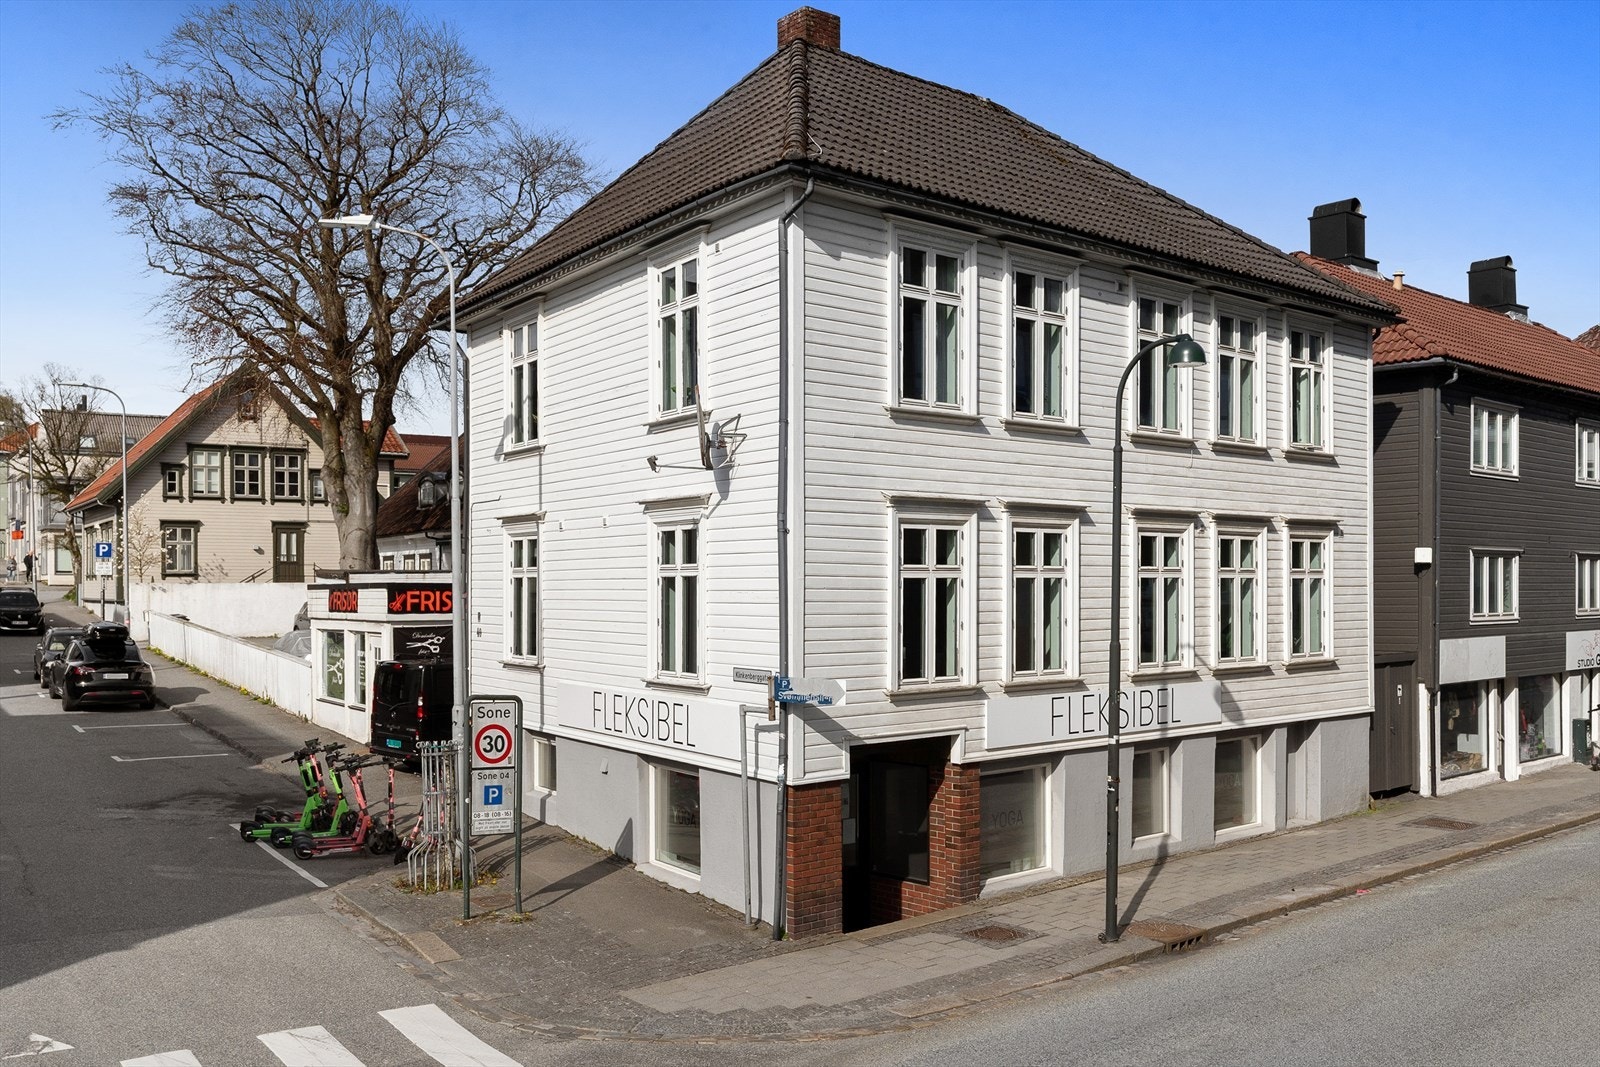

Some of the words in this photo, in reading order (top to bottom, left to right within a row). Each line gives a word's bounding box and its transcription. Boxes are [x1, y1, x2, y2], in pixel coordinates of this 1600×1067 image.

[99, 544, 109, 557] P
[1577, 658, 1595, 668] STUDIO
[781, 680, 788, 688] P
[477, 706, 511, 719] Sone
[1051, 687, 1181, 737] FLEKSIBEL
[593, 691, 696, 748] FLEKSIBEL
[482, 734, 505, 753] 30
[477, 772, 498, 780] Sone
[488, 787, 499, 803] P
[991, 809, 1025, 829] YOGA
